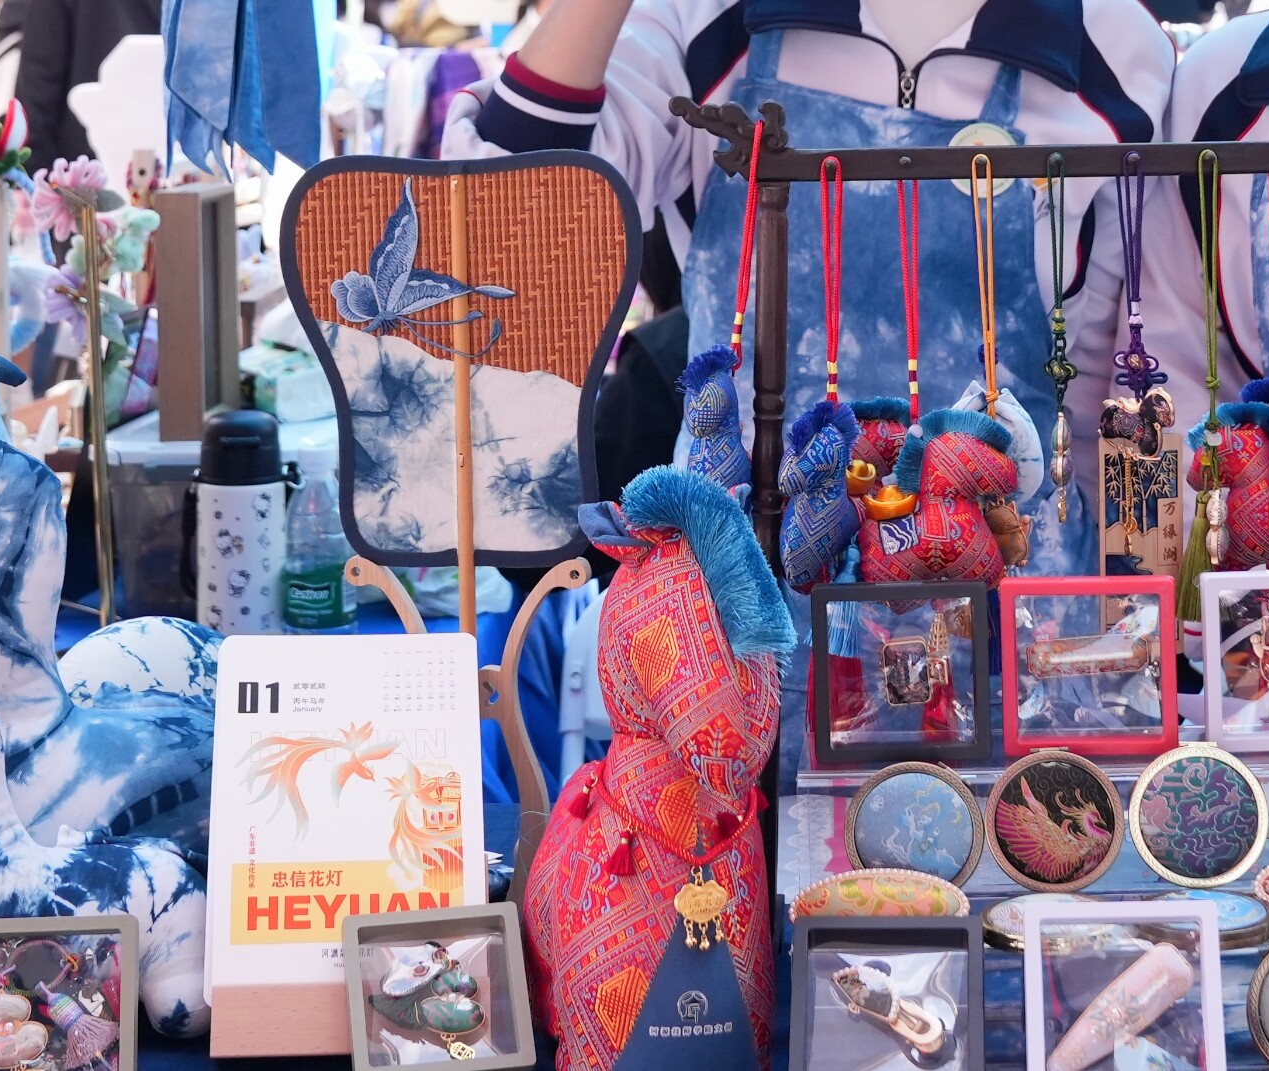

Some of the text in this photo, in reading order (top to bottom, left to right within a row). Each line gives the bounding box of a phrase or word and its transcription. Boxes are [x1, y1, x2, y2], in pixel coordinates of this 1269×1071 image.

[238, 681, 280, 714] 01
[271, 869, 343, 888] 忠信花灯
